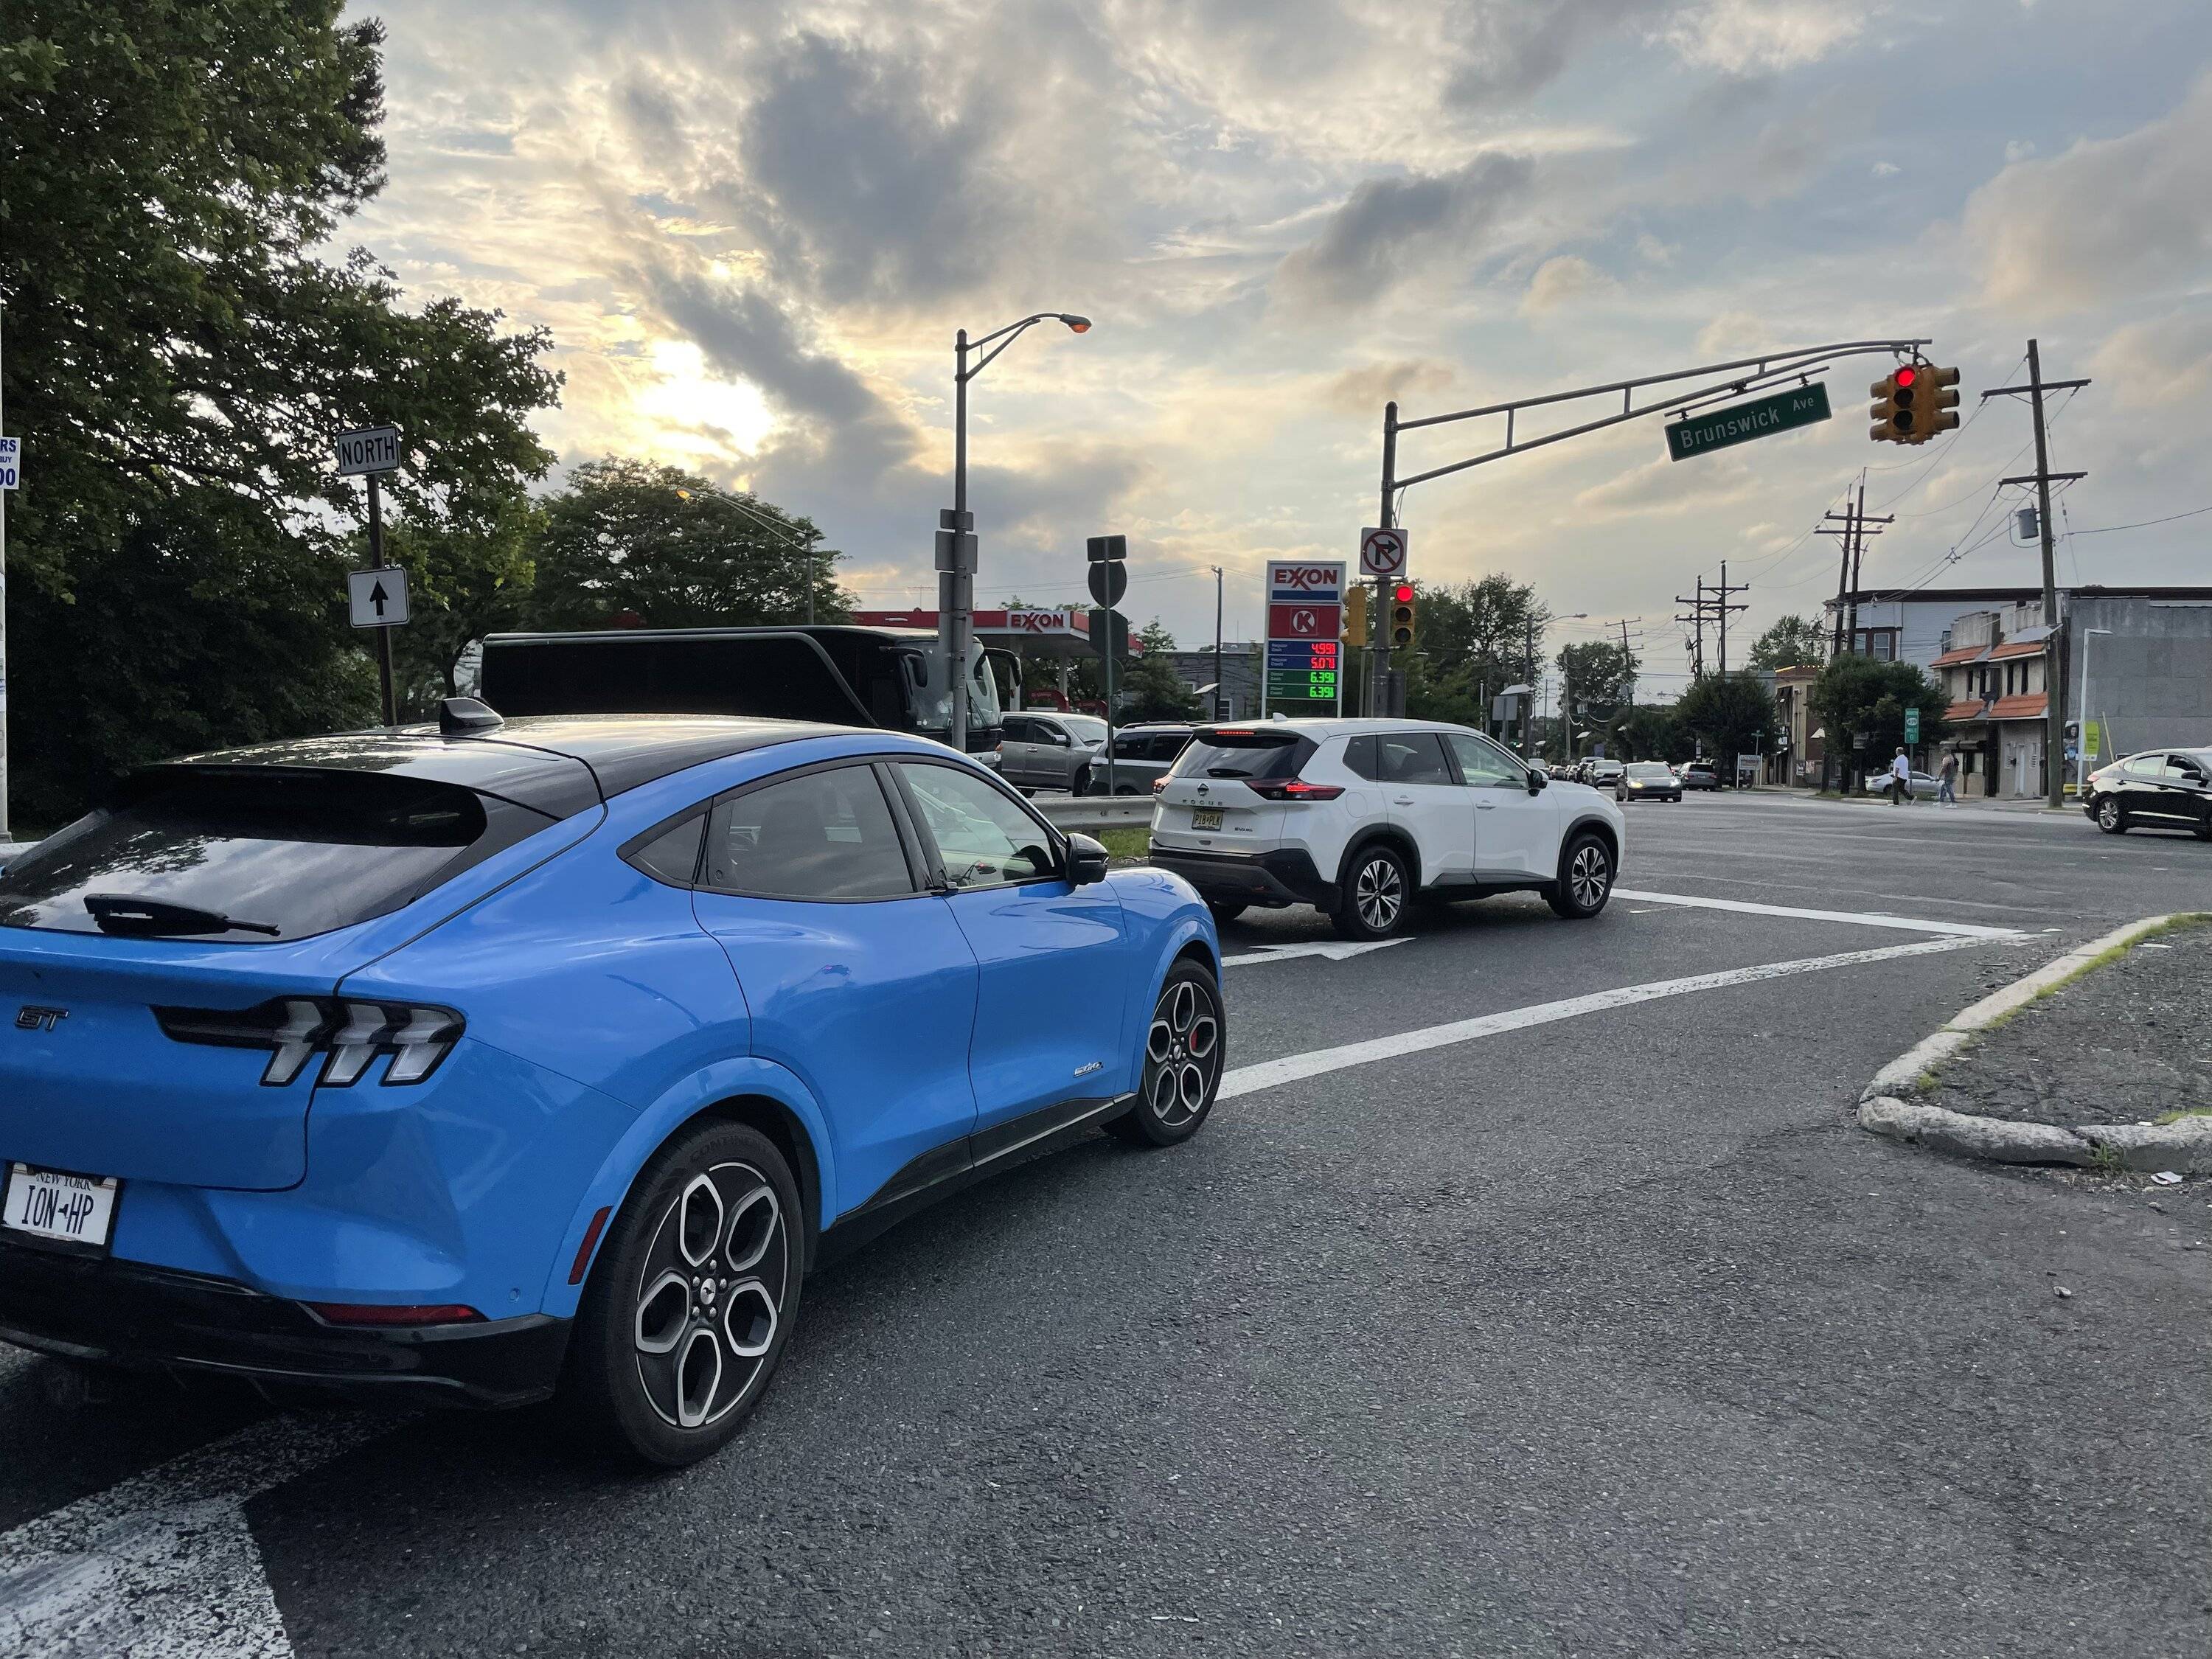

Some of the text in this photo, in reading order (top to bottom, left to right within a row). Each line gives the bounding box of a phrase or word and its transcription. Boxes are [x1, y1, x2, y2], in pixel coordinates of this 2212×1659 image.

[1680, 396, 1815, 449] Brunswick Ave
[341, 435, 395, 467] NORTH
[1274, 566, 1338, 590] EXXON
[1011, 612, 1065, 633] EXXON
[15, 1005, 69, 1032] GT
